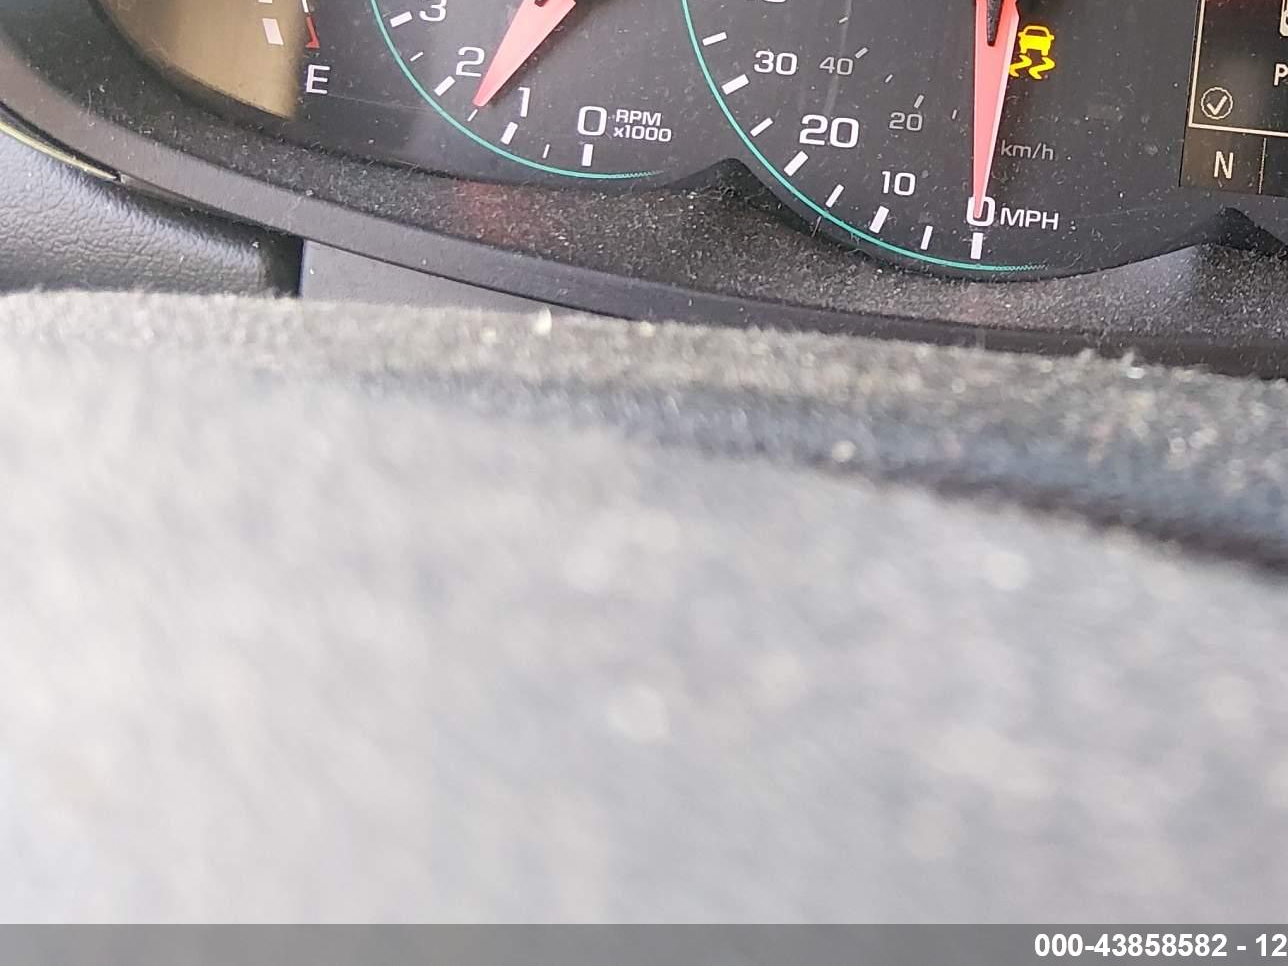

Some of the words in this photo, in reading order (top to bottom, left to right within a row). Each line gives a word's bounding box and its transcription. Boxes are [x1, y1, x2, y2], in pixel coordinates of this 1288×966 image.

[456, 47, 485, 78] 2
[754, 51, 798, 75] 30
[819, 56, 854, 76] 40
[306, 65, 331, 95] E
[519, 87, 532, 117] 1
[577, 105, 606, 137] 0
[615, 108, 662, 126] RPM
[613, 125, 672, 143] x1000
[800, 115, 859, 148] 20
[889, 112, 924, 131] 20
[1001, 141, 1055, 161] km/h
[1213, 151, 1235, 180] N
[882, 170, 916, 196] 10
[966, 196, 994, 227] 0
[1000, 207, 1060, 230] MPH
